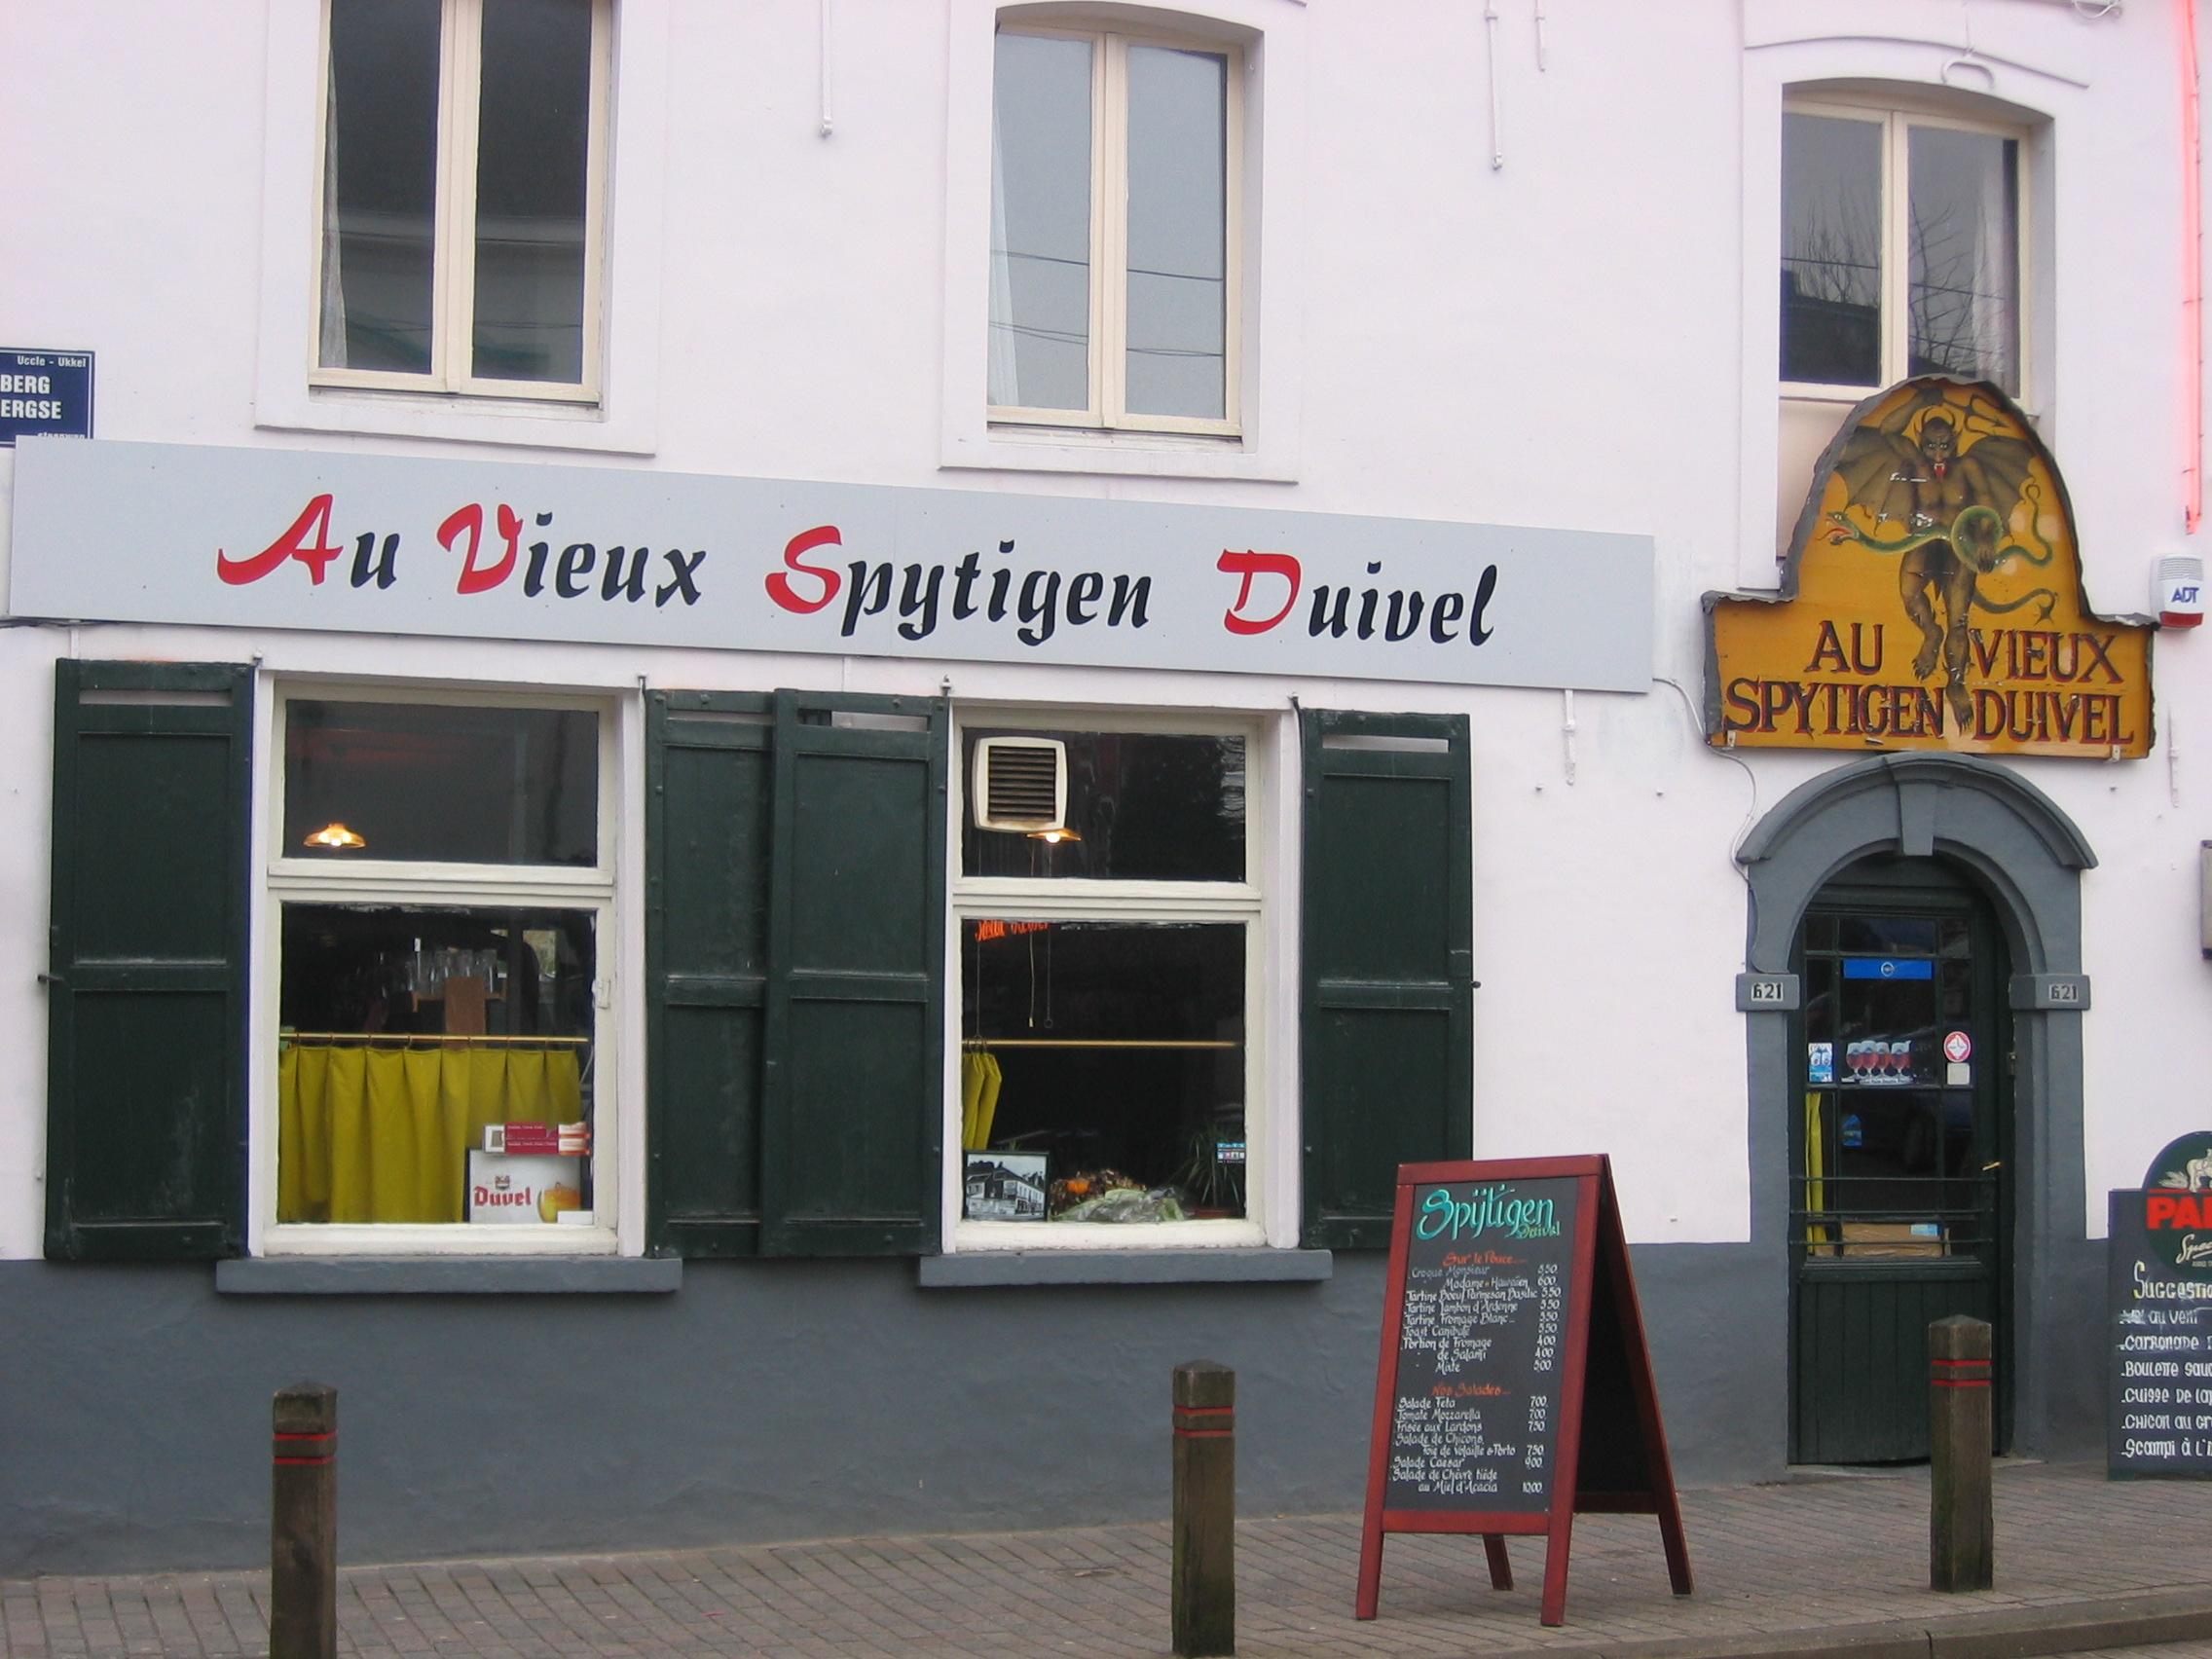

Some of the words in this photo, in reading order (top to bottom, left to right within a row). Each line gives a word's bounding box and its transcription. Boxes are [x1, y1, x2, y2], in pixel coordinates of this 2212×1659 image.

[57, 356, 87, 368] Ukkel
[0, 374, 51, 394] BERG
[0, 399, 62, 420] ERGSE
[216, 493, 401, 589] Au
[436, 502, 707, 608] Vieux
[764, 524, 1153, 647] Spytigen
[1217, 548, 1497, 647] Duivel
[2171, 586, 2200, 604] ADT
[1803, 619, 1884, 675] AU
[1969, 628, 2124, 684] VIEUX
[1723, 677, 1946, 740] SPYTIGEN
[1972, 688, 2135, 746] DUIVEL
[1752, 982, 1783, 1000] 621
[2050, 984, 2078, 1000] 621
[473, 1185, 532, 1207] Duvel
[2146, 1196, 2212, 1231] PA
